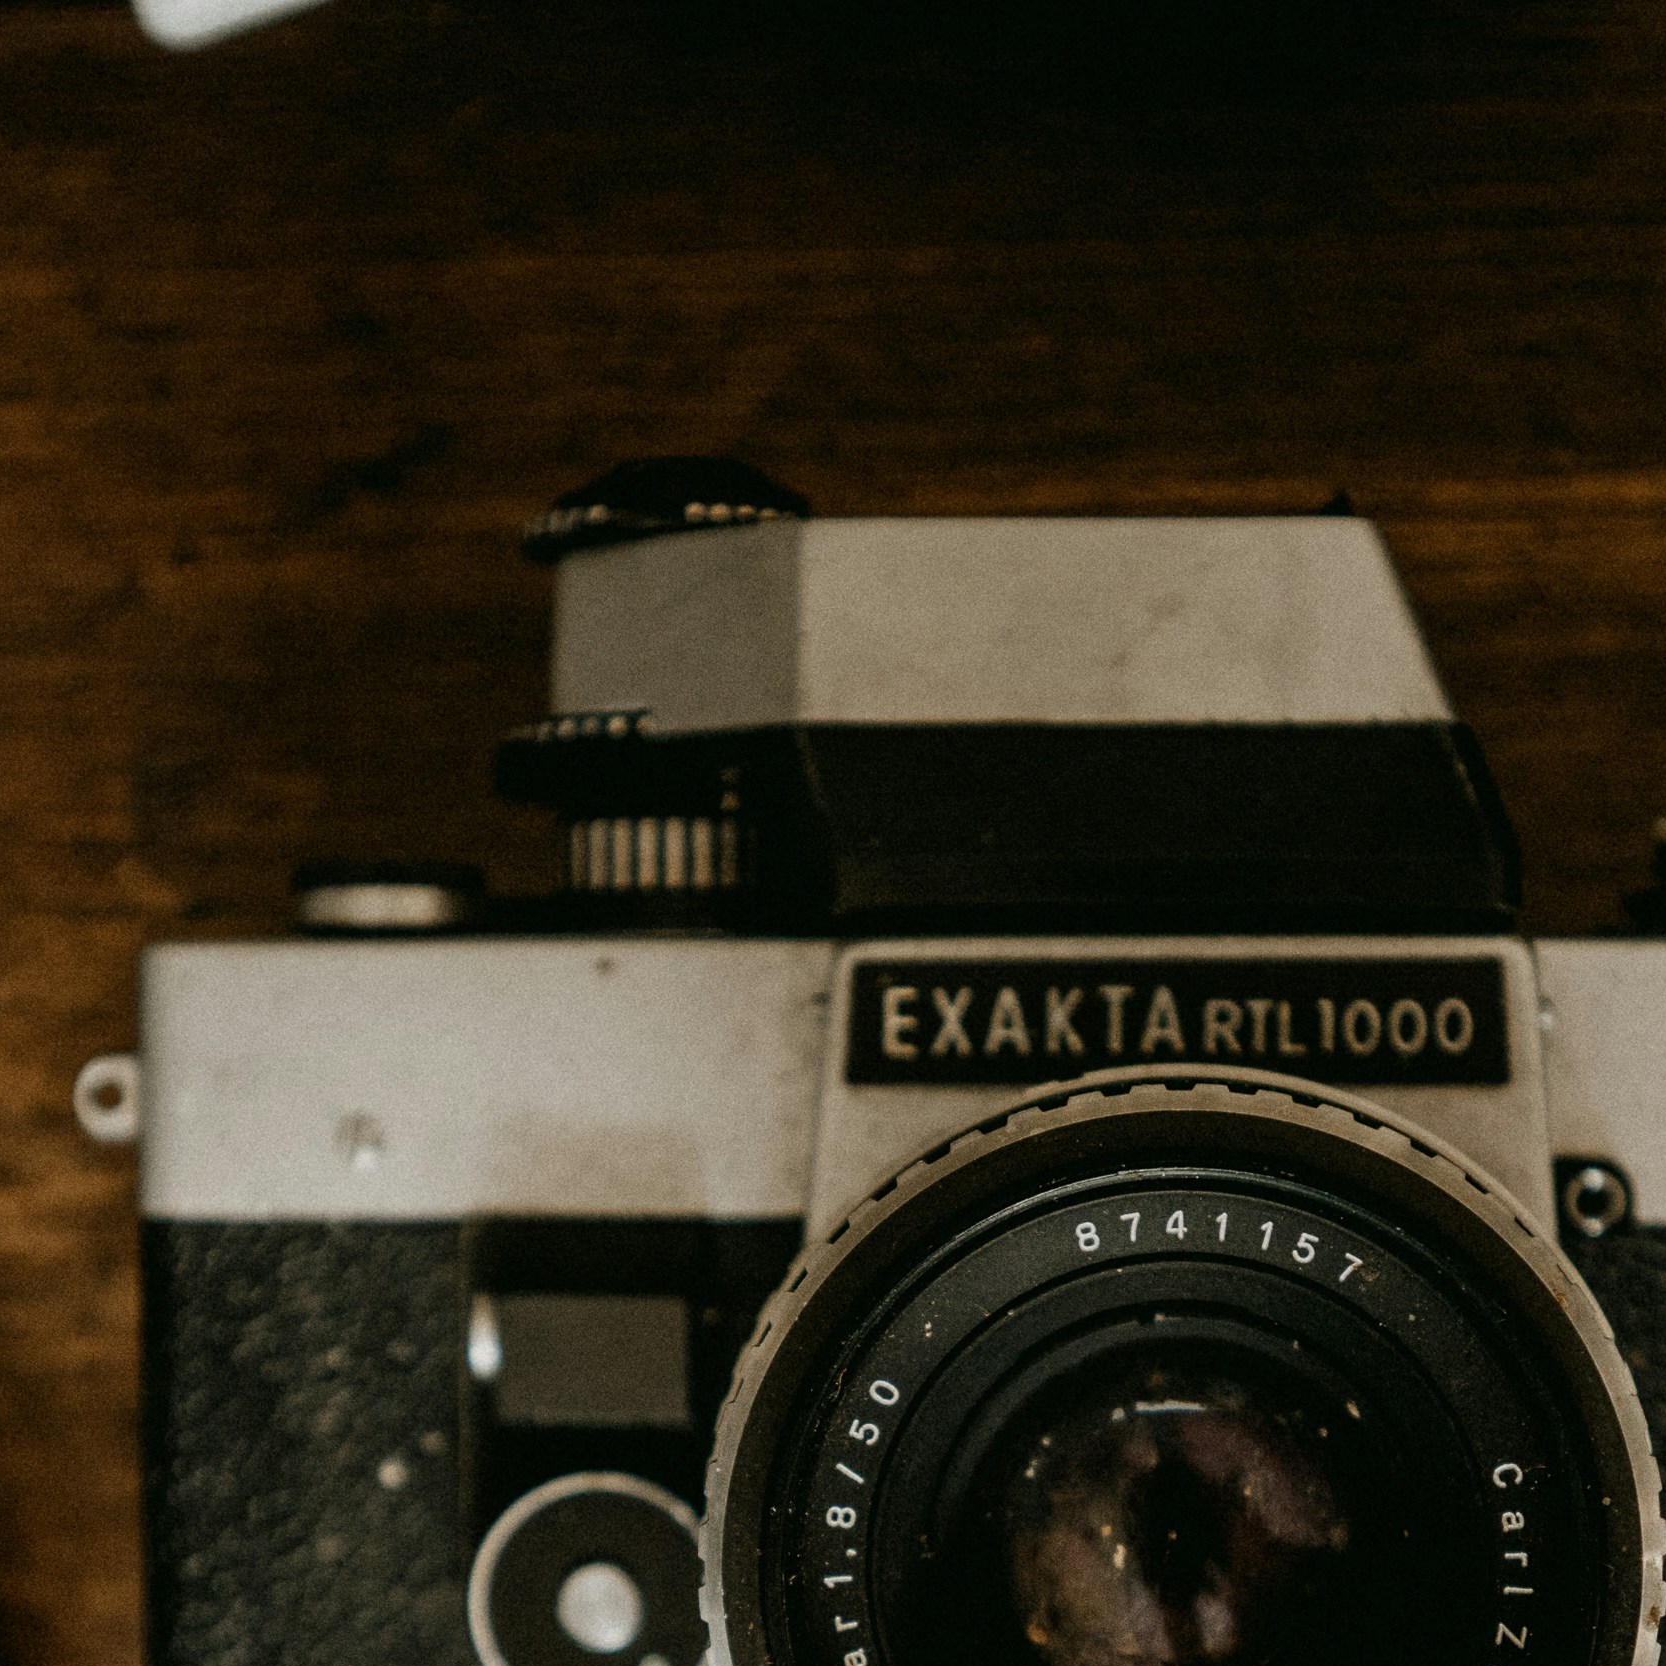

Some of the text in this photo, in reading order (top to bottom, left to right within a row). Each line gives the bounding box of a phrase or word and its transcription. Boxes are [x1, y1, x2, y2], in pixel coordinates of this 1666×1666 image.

[881, 984, 1474, 1059] EXAKTA RTL 1000
[1073, 1208, 1364, 1283] 8741157
[1491, 1461, 1535, 1596] Carl
